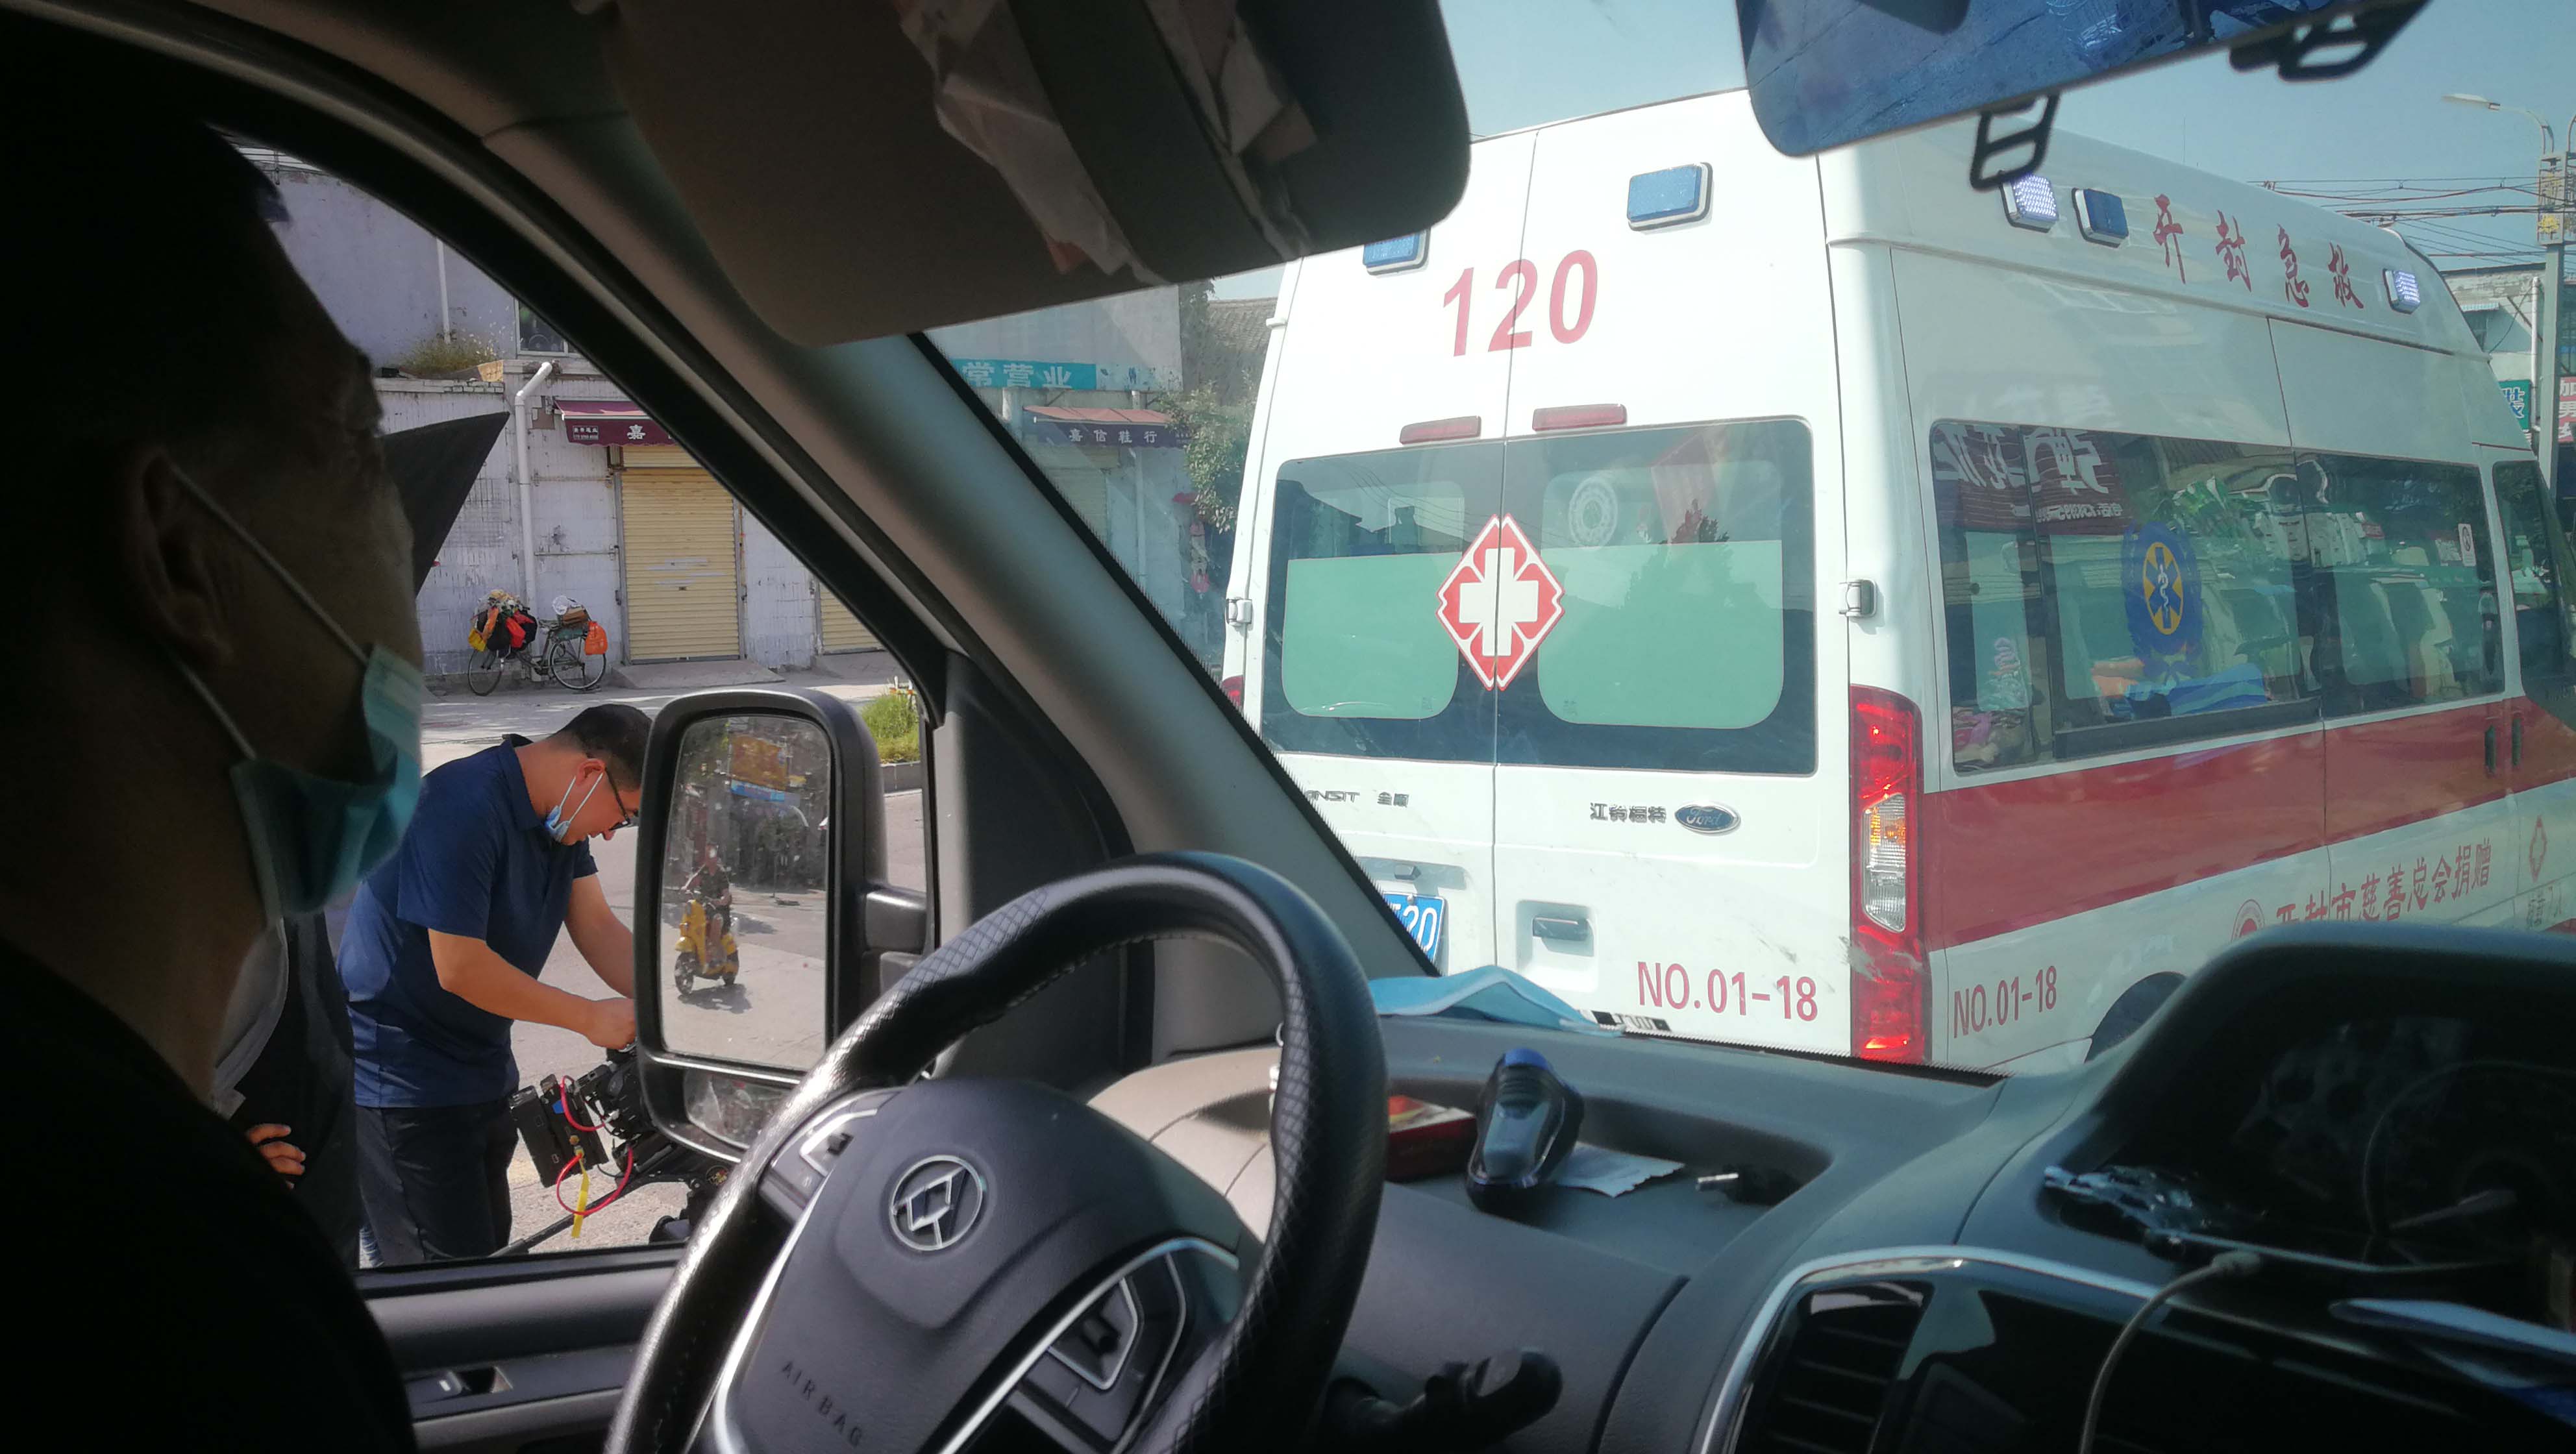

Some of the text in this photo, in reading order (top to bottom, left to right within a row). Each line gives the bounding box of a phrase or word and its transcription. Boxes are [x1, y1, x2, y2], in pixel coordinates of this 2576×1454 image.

[1443, 249, 1598, 357] 120
[961, 362, 1072, 389] 常营业
[1069, 428, 1158, 444] 嘉信鞋行
[1391, 903, 1437, 952] 20
[1637, 961, 1818, 1022] NO.01-18
[1953, 965, 2057, 1039] NO.01-18
[782, 1361, 863, 1448] AIRBAG
